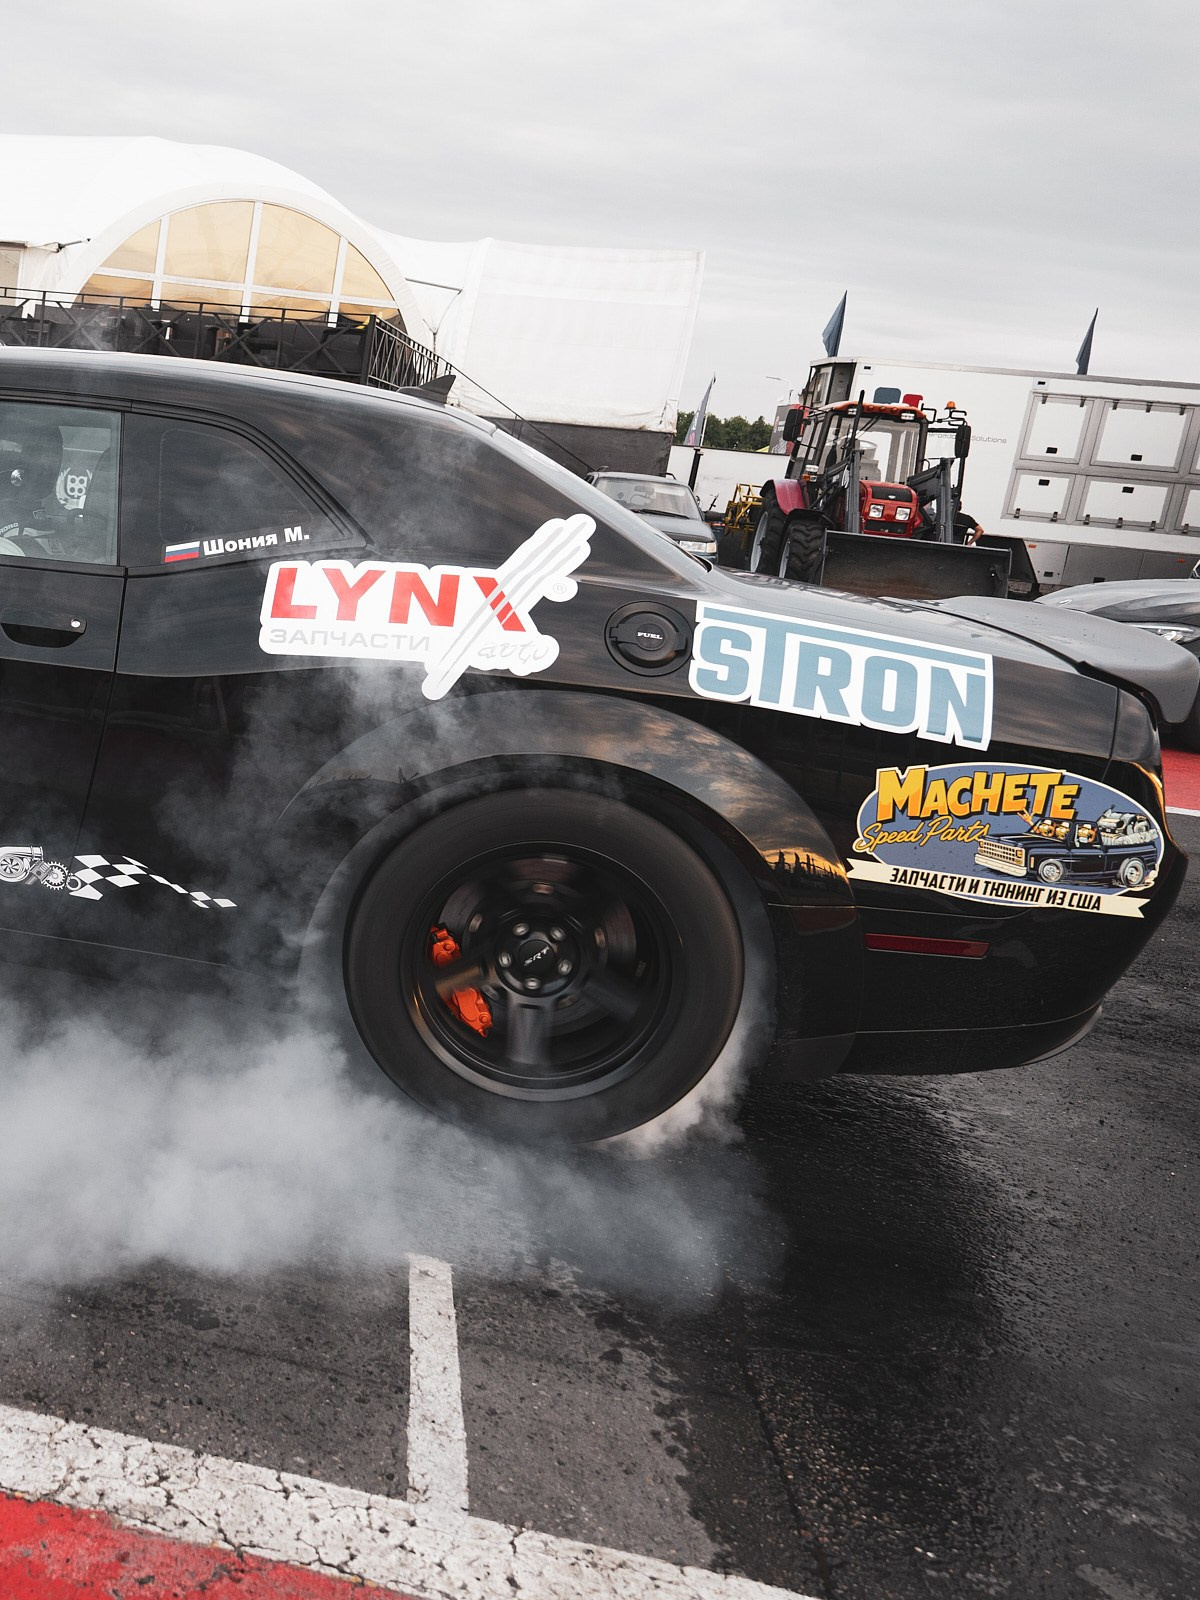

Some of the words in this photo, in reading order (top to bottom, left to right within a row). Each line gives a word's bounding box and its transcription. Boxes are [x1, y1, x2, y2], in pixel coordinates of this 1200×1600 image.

[203, 533, 278, 556] Шония
[284, 526, 310, 543] М.
[270, 567, 527, 633] LYNX
[269, 628, 431, 652] ЗАПЧАСТИ
[637, 631, 663, 640] FUEL
[695, 607, 987, 746] STRON
[876, 767, 1079, 822] MACHETE
[856, 821, 925, 851] Speed
[920, 815, 990, 846] Parts
[889, 867, 967, 894] ЗАПЧАСТИ
[967, 879, 978, 895] И
[982, 880, 1045, 904] ТЮНИНГ
[1046, 889, 1067, 906] ИЗ
[1067, 893, 1102, 911] США
[524, 946, 550, 966] SRT
